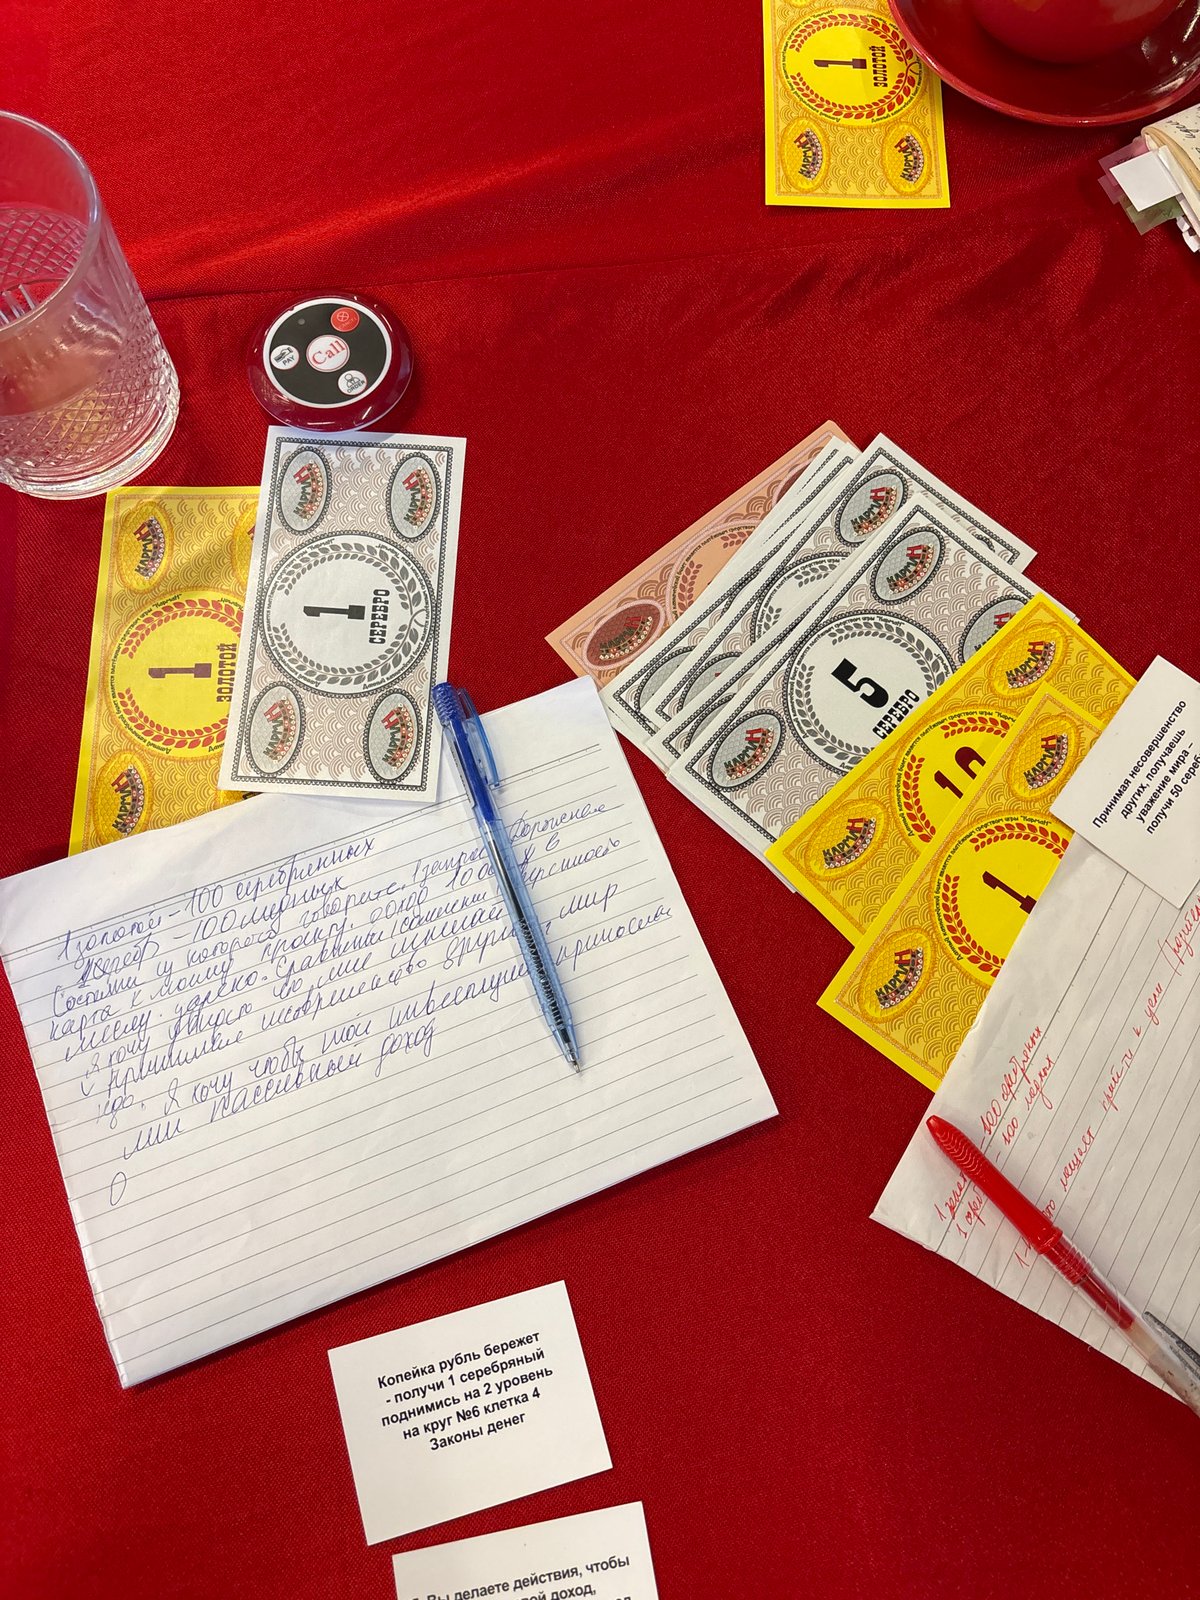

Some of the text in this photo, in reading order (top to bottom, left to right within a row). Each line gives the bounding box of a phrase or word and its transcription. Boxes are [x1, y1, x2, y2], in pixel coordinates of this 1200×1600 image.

[814, 58, 867, 70] 1
[869, 46, 888, 88] ЗОЛОТОЙ
[282, 355, 296, 366] PAY
[312, 340, 346, 366] Call
[347, 380, 366, 394] ORDER
[303, 605, 366, 620] 1
[369, 589, 390, 644] СЕРЕБРО
[148, 663, 212, 678] 1
[216, 642, 237, 702] ЗОЛОТОЙ
[831, 658, 889, 708] 5
[872, 689, 920, 740] СЕРЕБРО
[1092, 700, 1187, 828] Принимая несовершенство
[1121, 728, 1186, 819] других, получаешь
[1136, 776, 1172, 824] уважение
[1169, 751, 1190, 776] мира
[1146, 753, 1200, 834] получи 50 сереб
[185, 884, 223, 917] 100
[559, 883, 618, 919] мир
[982, 871, 1037, 914] 1
[193, 909, 236, 943] 100
[50, 1005, 121, 1041] карта
[1132, 1026, 1142, 1038] к
[375, 1017, 437, 1078] доход
[164, 1077, 180, 1116] Я
[192, 1071, 233, 1106] хочу
[980, 1099, 1001, 1135] 100
[1002, 1117, 1019, 1145] 100
[378, 1332, 540, 1389] Копейка рубль бережет
[394, 1380, 445, 1404] получи
[448, 1374, 455, 1386] 1
[460, 1348, 546, 1384] серебряный
[381, 1366, 554, 1427] поднимись на 2 уровень
[403, 1386, 541, 1440] на круг №6 клетка 4
[429, 1411, 527, 1451] Законы денег
[453, 1580, 510, 1600] делаете
[513, 1564, 583, 1590] действия,
[585, 1554, 630, 1574] чтобы
[550, 1582, 596, 1600] доход,
